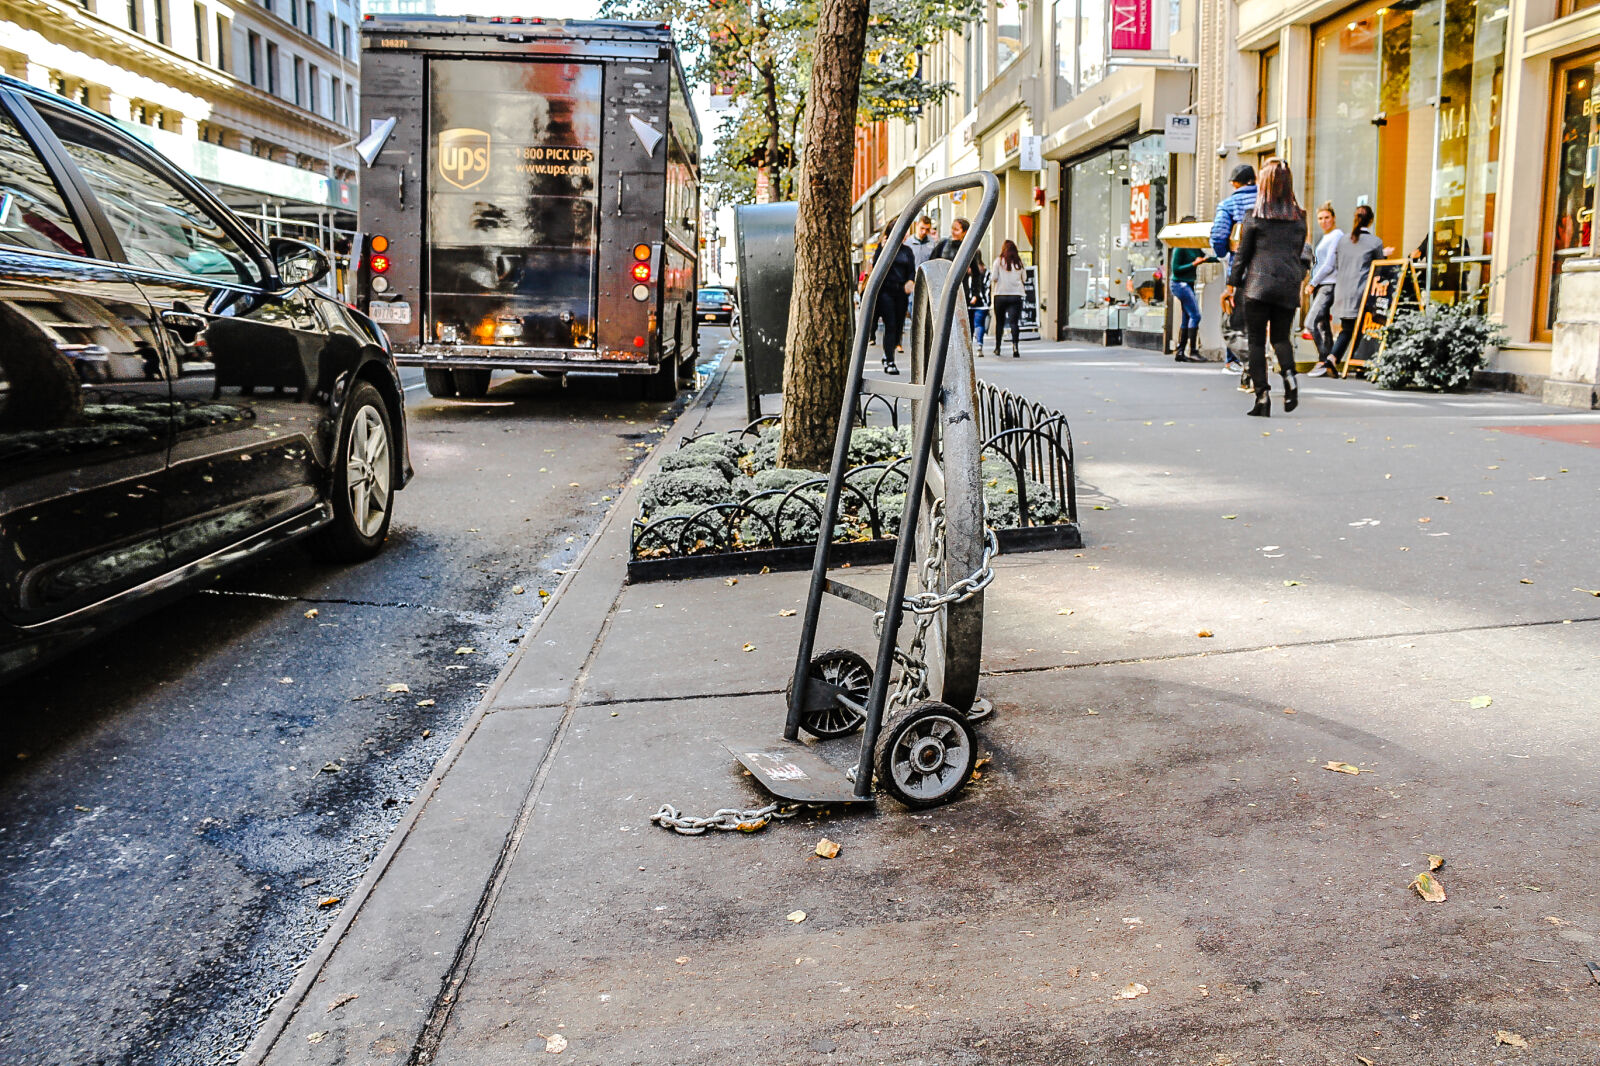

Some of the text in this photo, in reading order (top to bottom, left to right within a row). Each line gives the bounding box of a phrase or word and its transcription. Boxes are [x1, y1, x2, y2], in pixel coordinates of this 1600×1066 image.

[523, 148, 544, 160] 800
[546, 149, 570, 160] PICK
[572, 149, 593, 161] UPS
[442, 146, 487, 181] ups
[515, 164, 591, 177] www.ups.com
